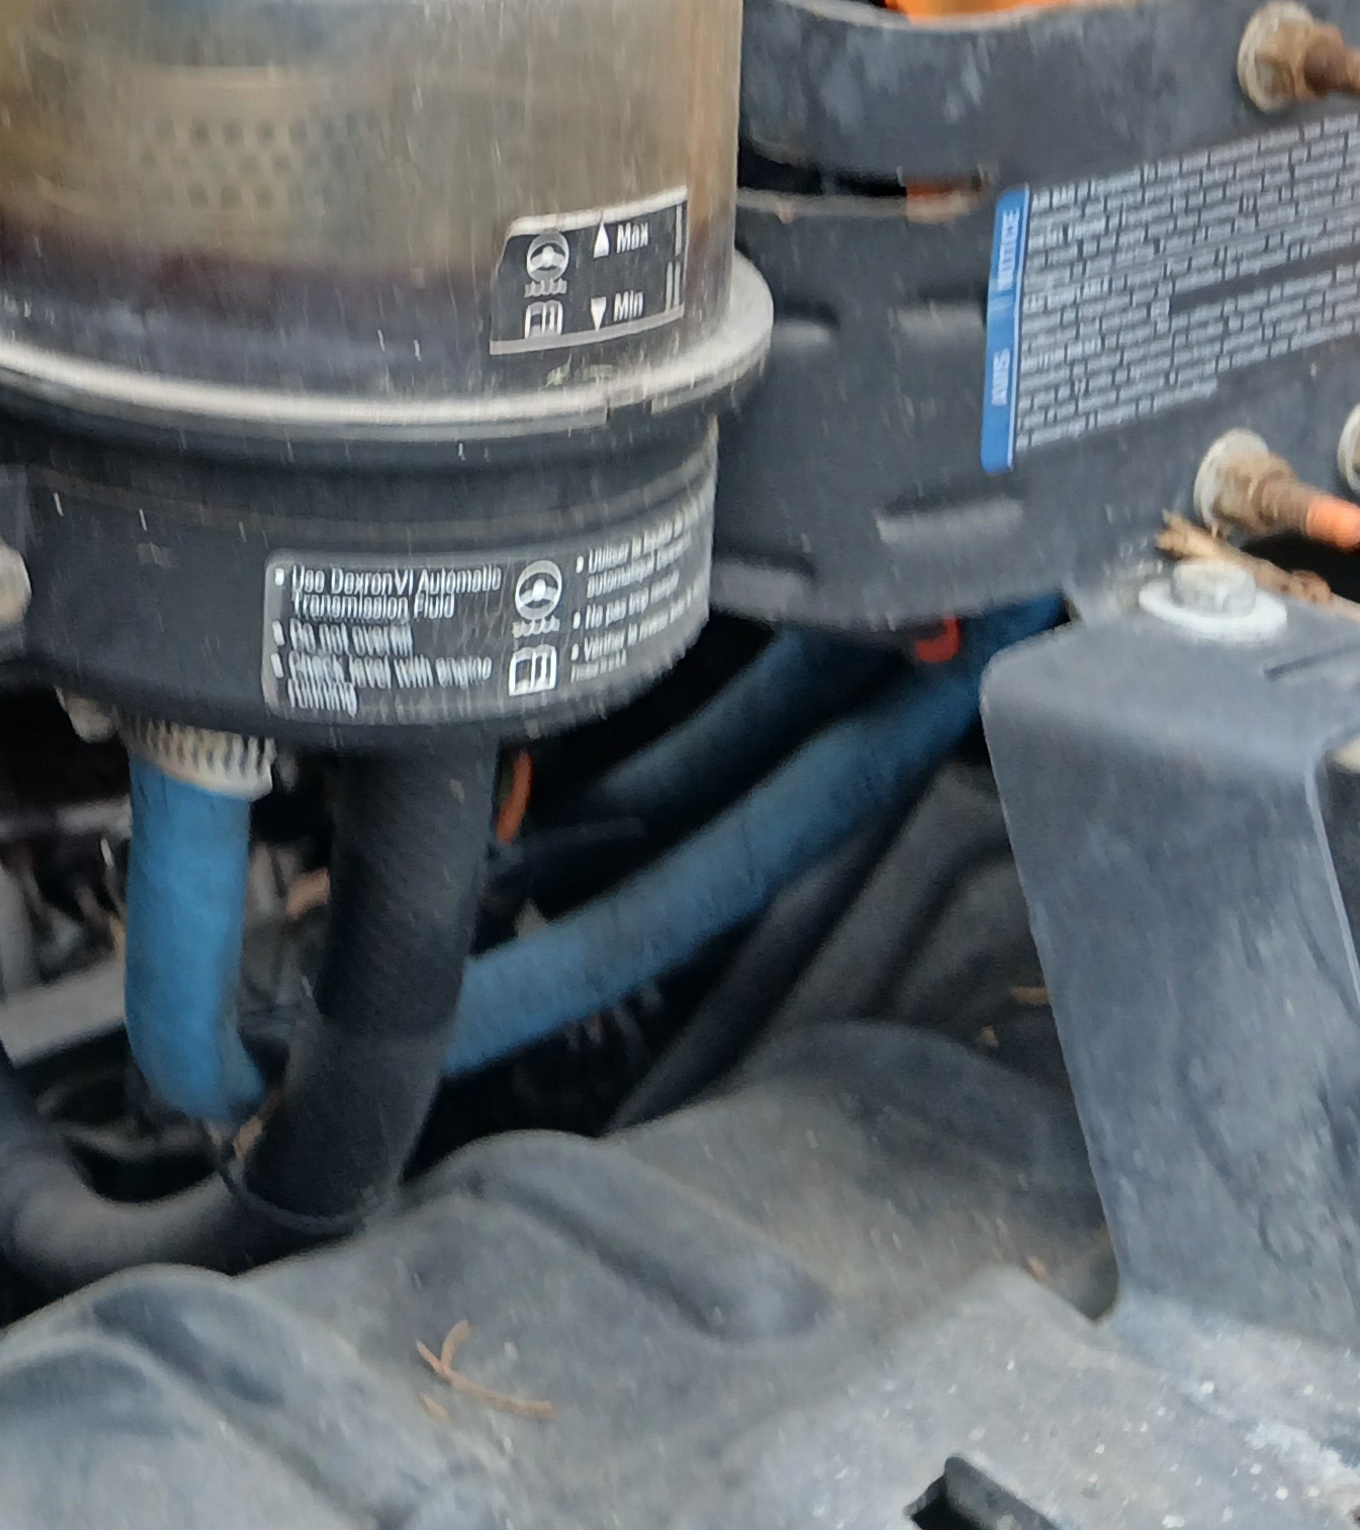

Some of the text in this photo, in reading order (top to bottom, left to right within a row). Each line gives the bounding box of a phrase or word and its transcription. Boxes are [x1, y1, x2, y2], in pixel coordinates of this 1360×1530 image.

[616, 222, 649, 253] Max
[613, 290, 644, 322] Min
[292, 565, 325, 594] Use
[418, 564, 501, 596] Automatic
[293, 591, 455, 621] Transmission Fluid
[290, 618, 315, 653] Do
[319, 621, 349, 654] not
[349, 654, 392, 689] level
[394, 654, 434, 689] with
[435, 656, 492, 689] engine
